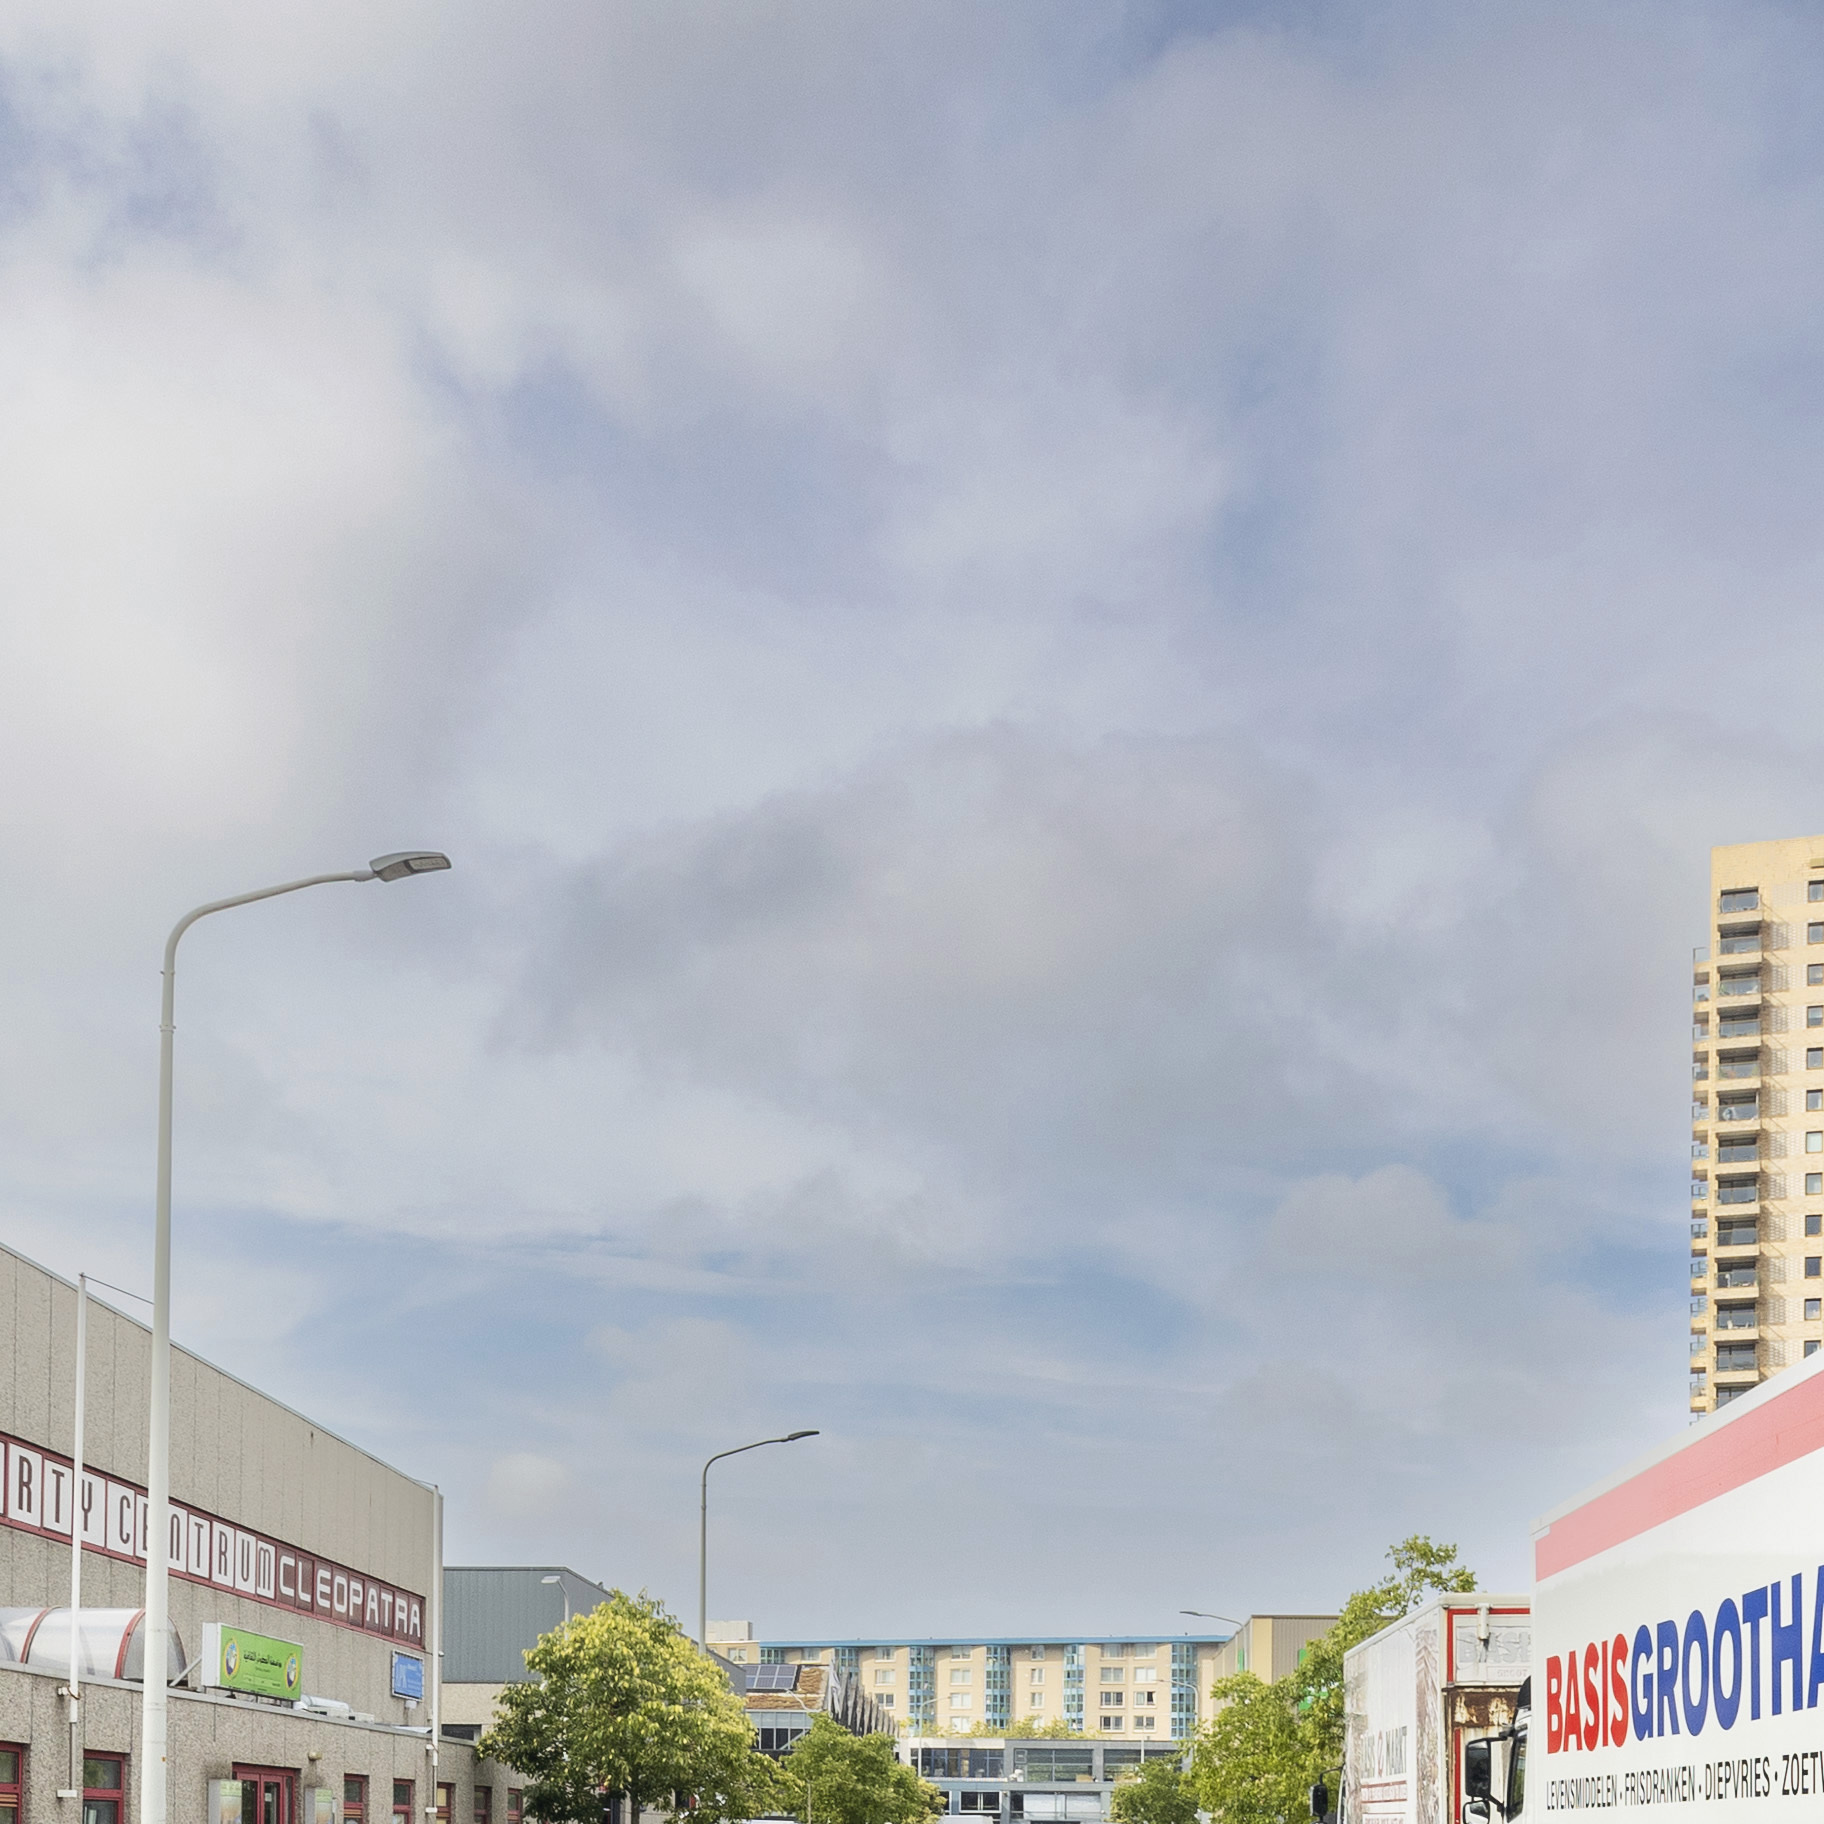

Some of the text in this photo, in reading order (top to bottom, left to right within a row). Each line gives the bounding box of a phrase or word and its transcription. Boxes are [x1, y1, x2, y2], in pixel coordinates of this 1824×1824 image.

[278, 1555, 422, 1638] CLEOPATRA
[1546, 1774, 1617, 1811] LEVENSMIDDELEN
[1625, 1766, 1695, 1806] FRISDRANKEN
[1705, 1757, 1771, 1801] DIEPVRIES
